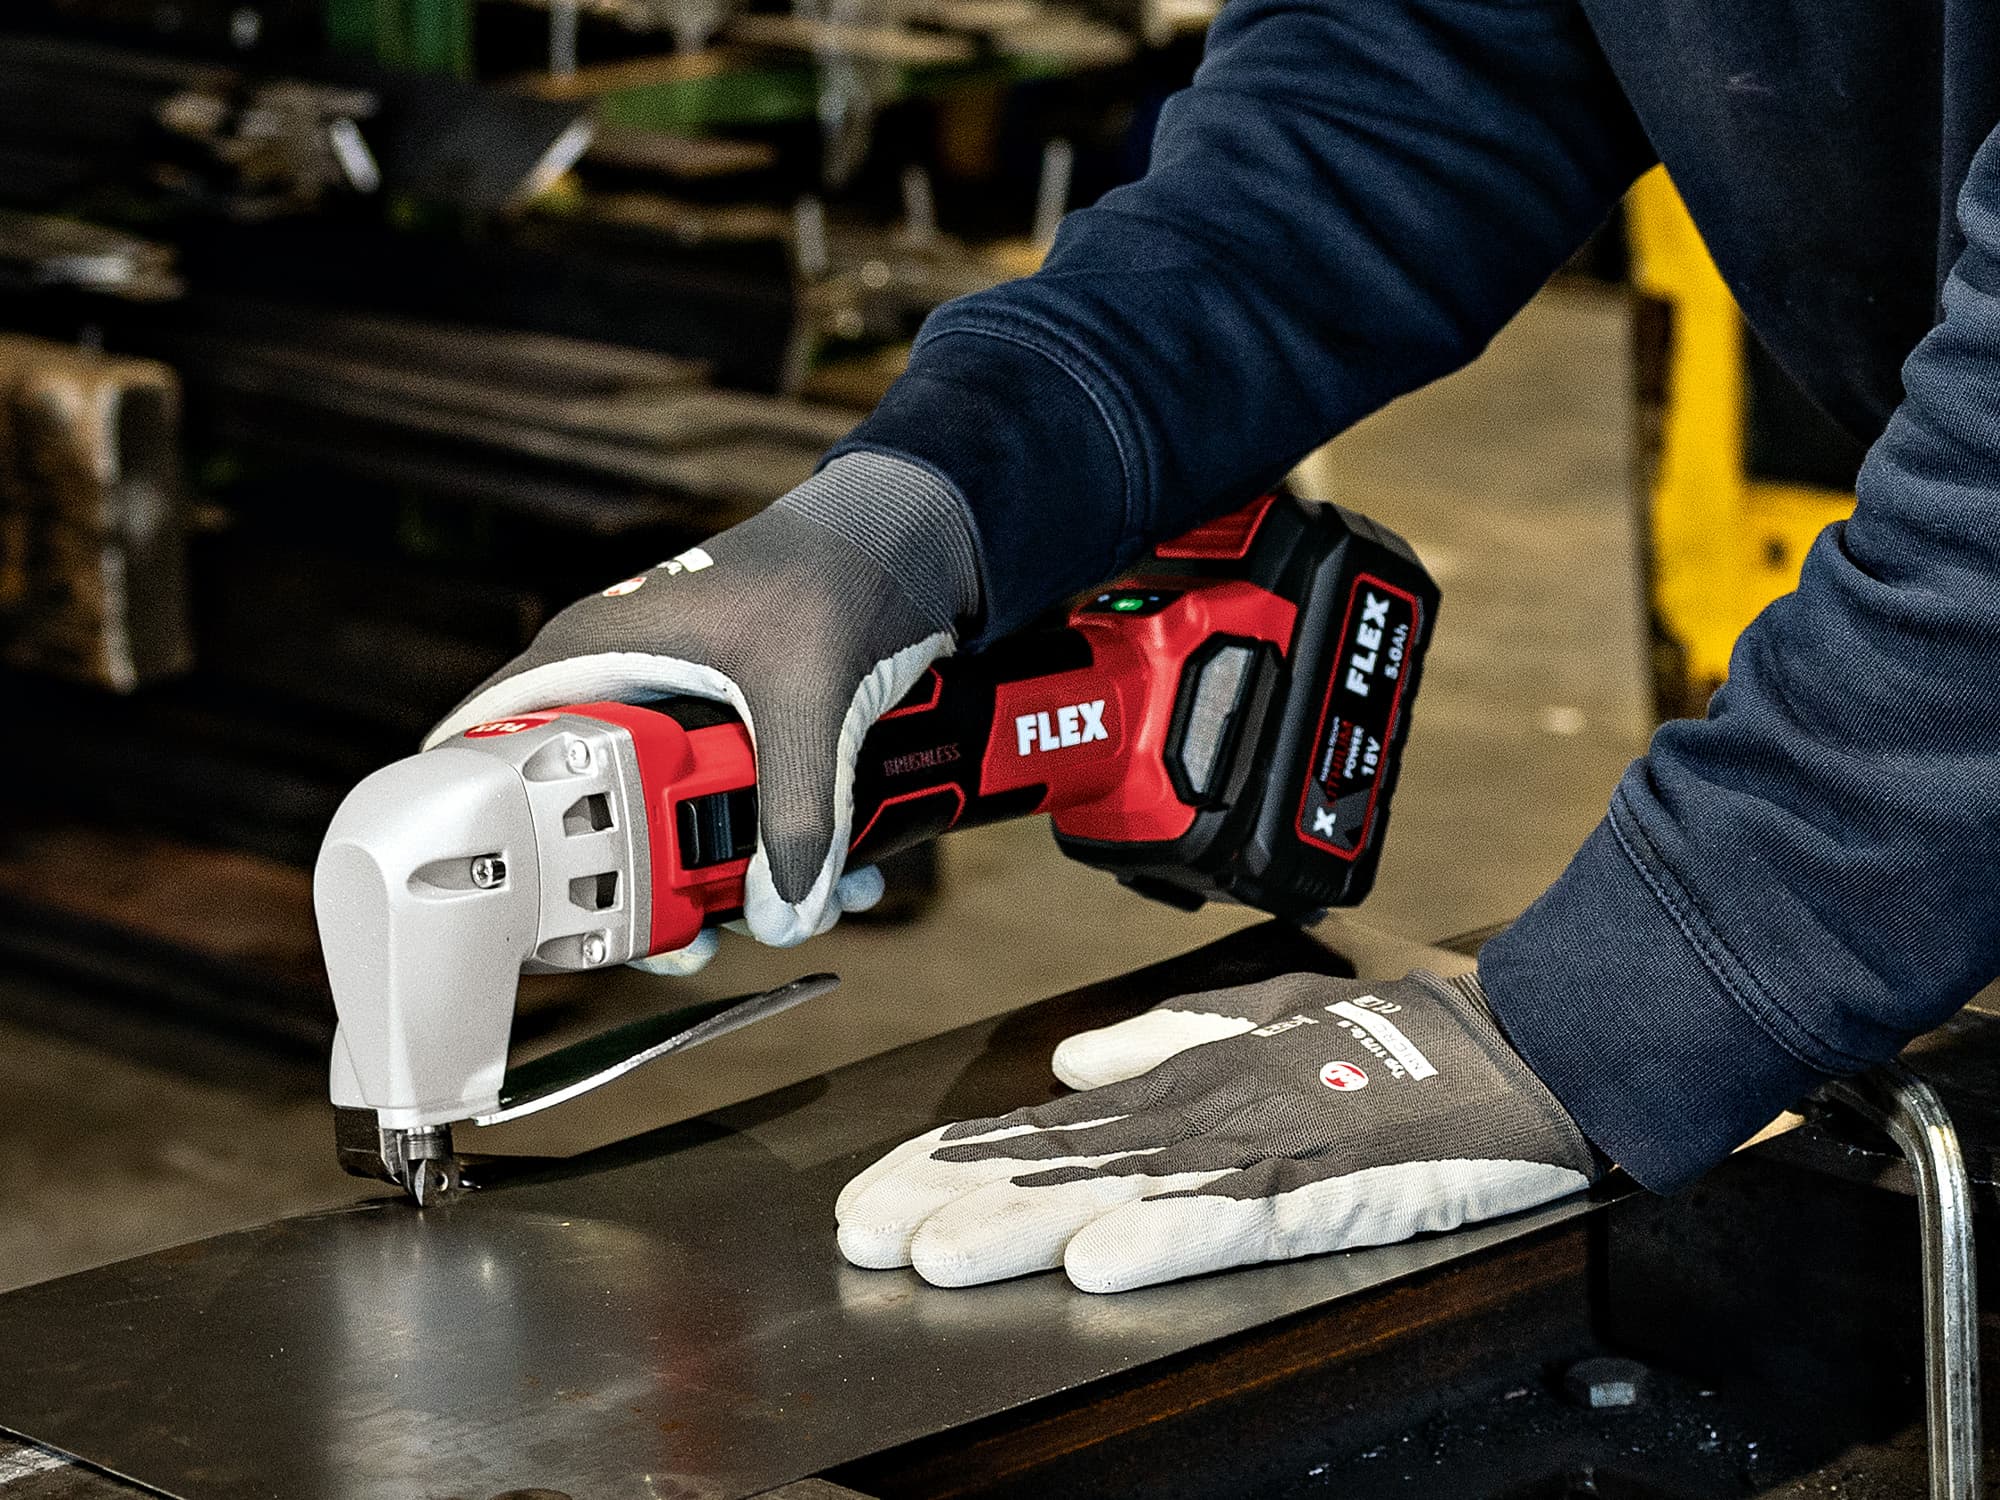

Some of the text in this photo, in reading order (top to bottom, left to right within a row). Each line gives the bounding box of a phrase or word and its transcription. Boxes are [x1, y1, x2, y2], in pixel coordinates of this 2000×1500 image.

[1345, 591, 1390, 697] FLEX
[1384, 623, 1409, 680] 5.0Ah
[1015, 700, 1108, 756] FLEX
[1342, 725, 1364, 779] POWER
[1361, 736, 1381, 776] 18V
[1312, 806, 1336, 837] X
